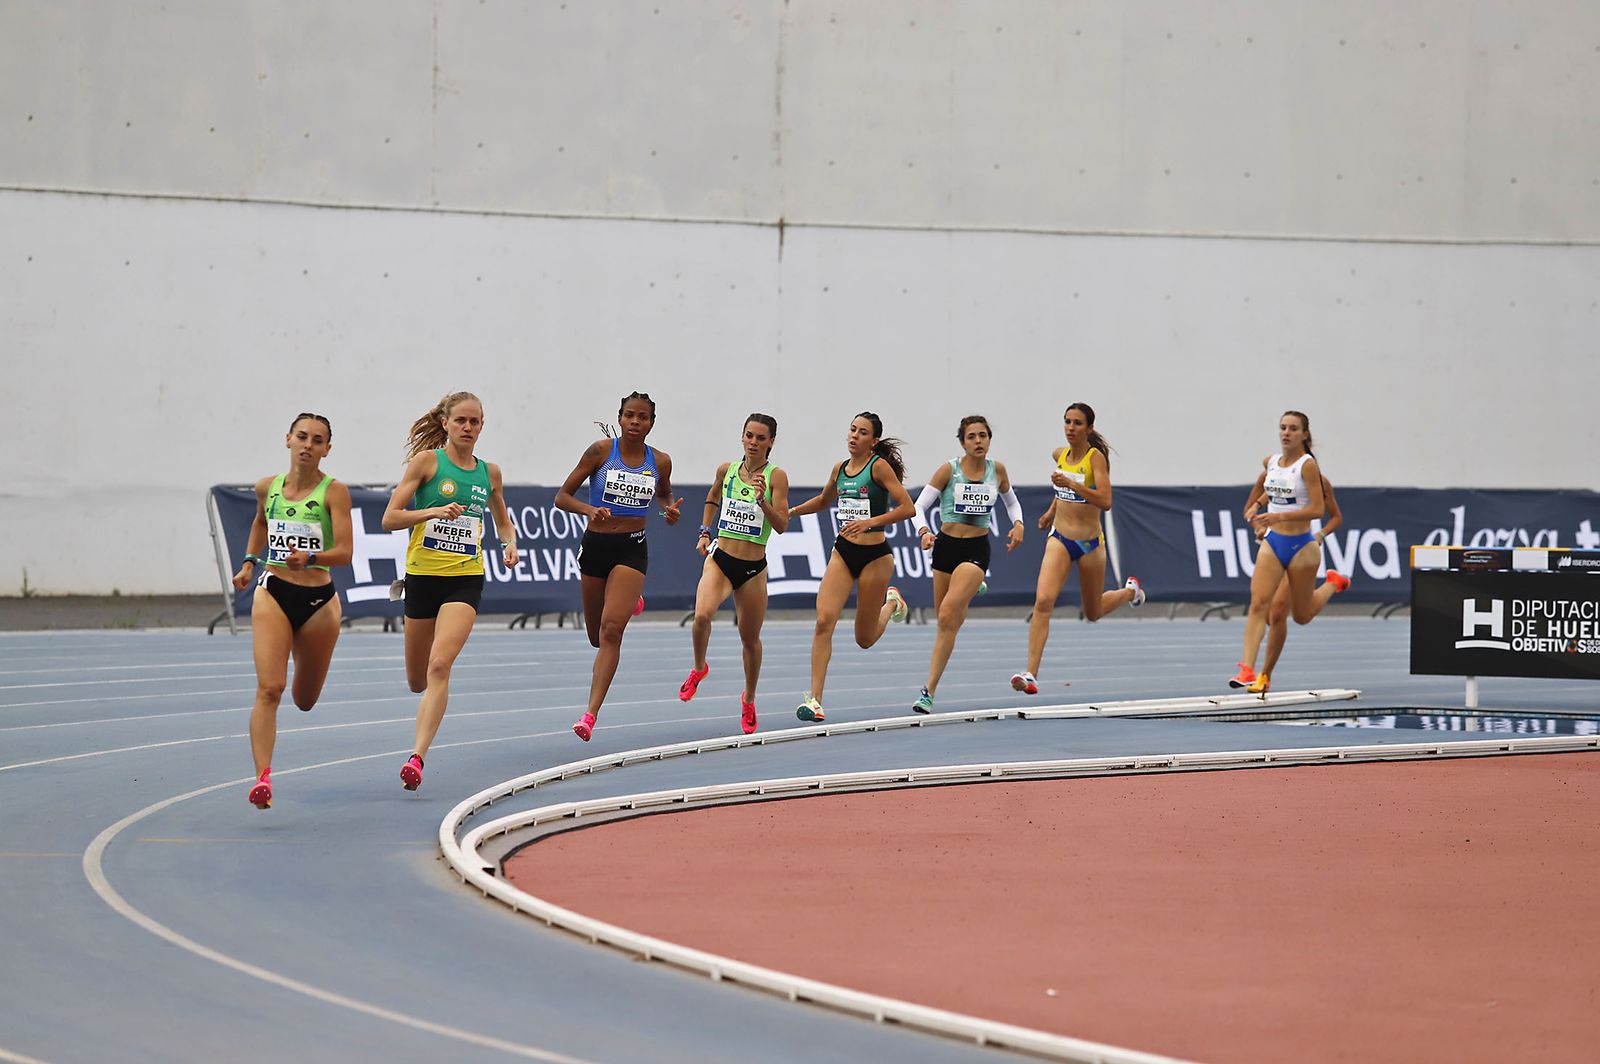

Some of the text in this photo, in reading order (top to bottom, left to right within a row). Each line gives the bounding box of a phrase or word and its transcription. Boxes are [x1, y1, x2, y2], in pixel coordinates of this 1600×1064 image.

[606, 481, 653, 495] ESCOBAR
[962, 493, 990, 501] RECIO
[726, 508, 756, 522] PRADO
[433, 524, 472, 538] WEBER
[269, 534, 321, 549] PACER
[1191, 509, 1402, 580] Hulva
[1512, 620, 1537, 638] DE
